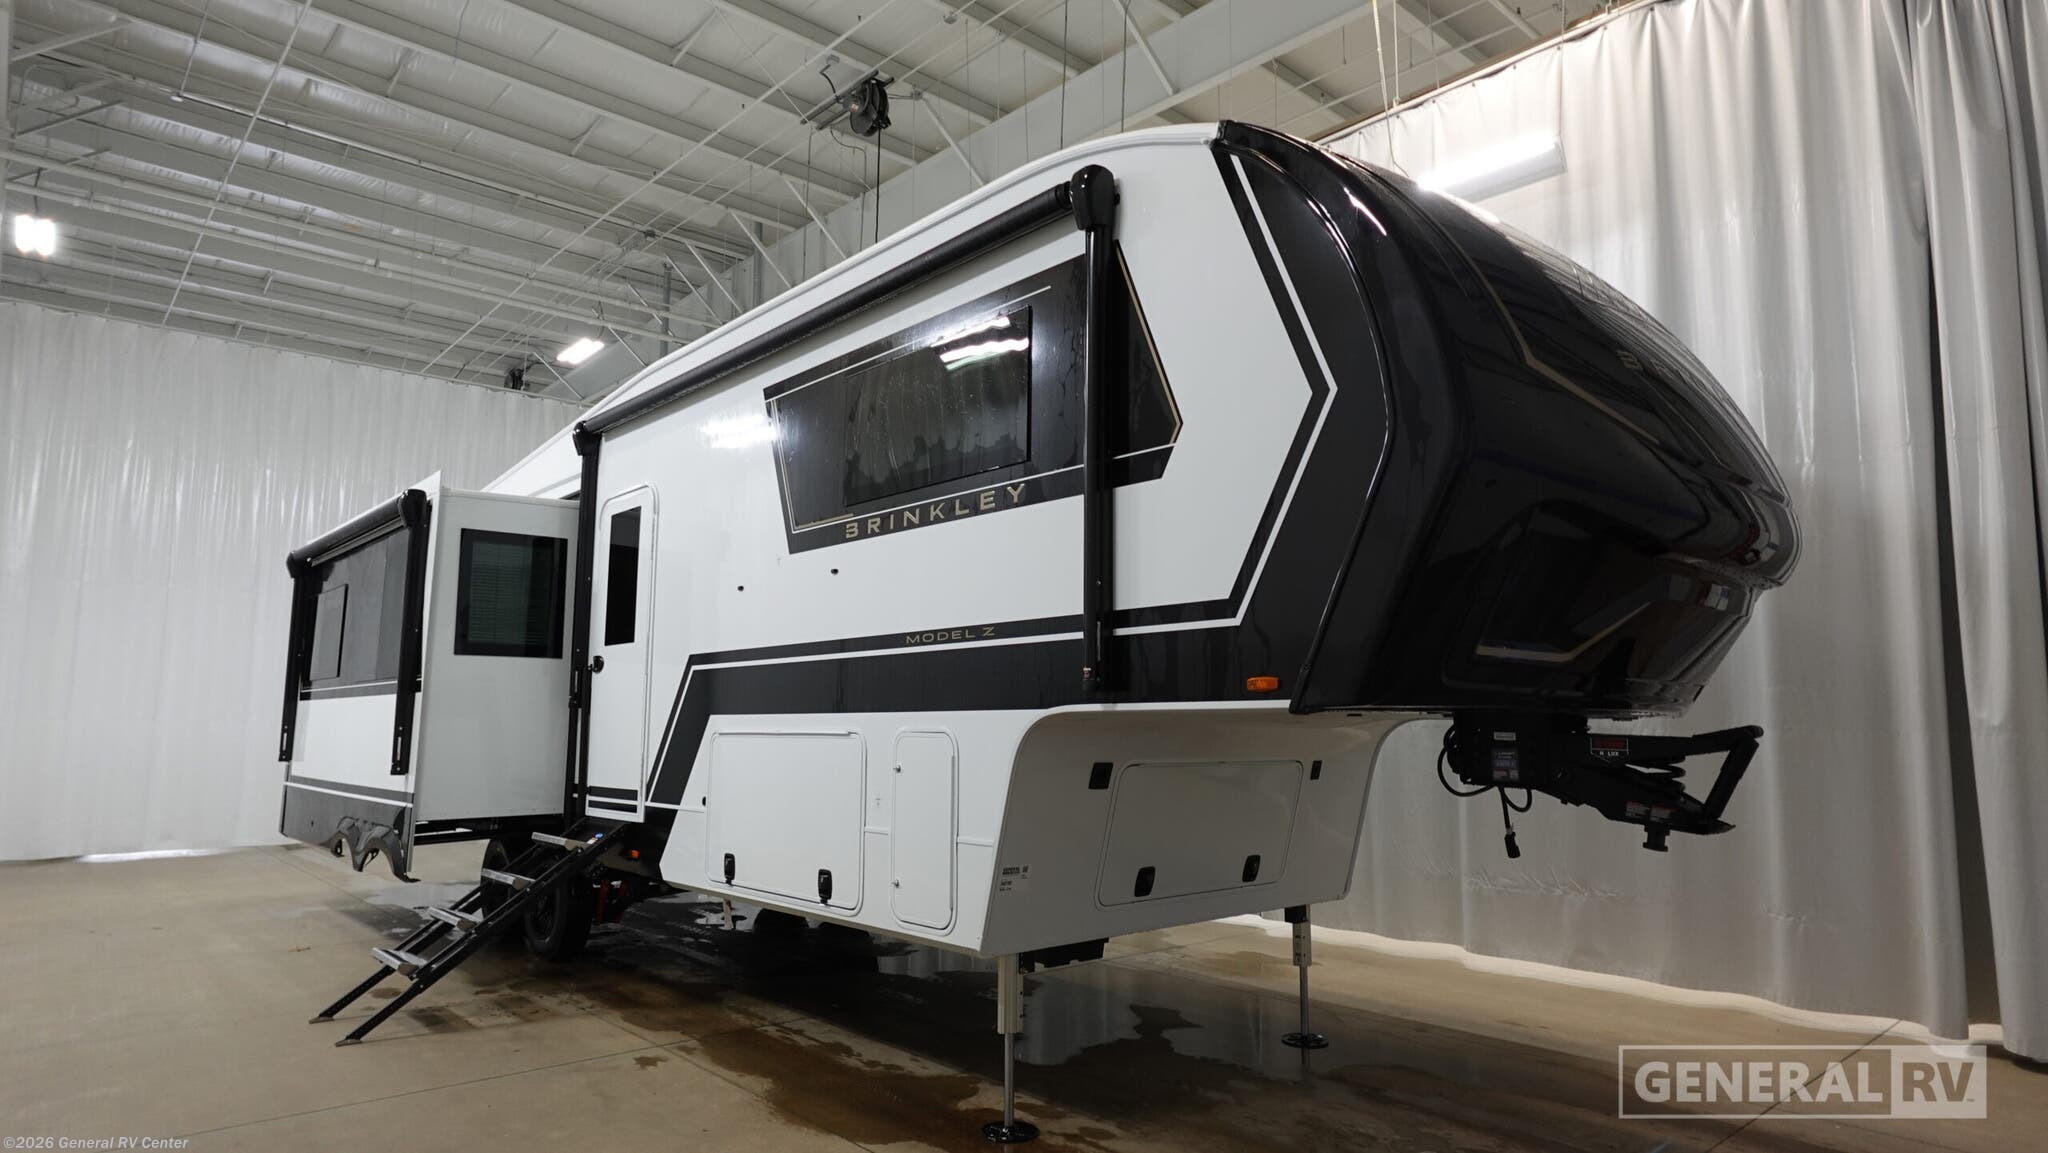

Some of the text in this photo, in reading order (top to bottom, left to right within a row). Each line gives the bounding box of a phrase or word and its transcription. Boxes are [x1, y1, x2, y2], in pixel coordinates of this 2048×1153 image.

[845, 483, 1026, 539] BRINKLEY
[905, 625, 996, 645] MODEL Z
